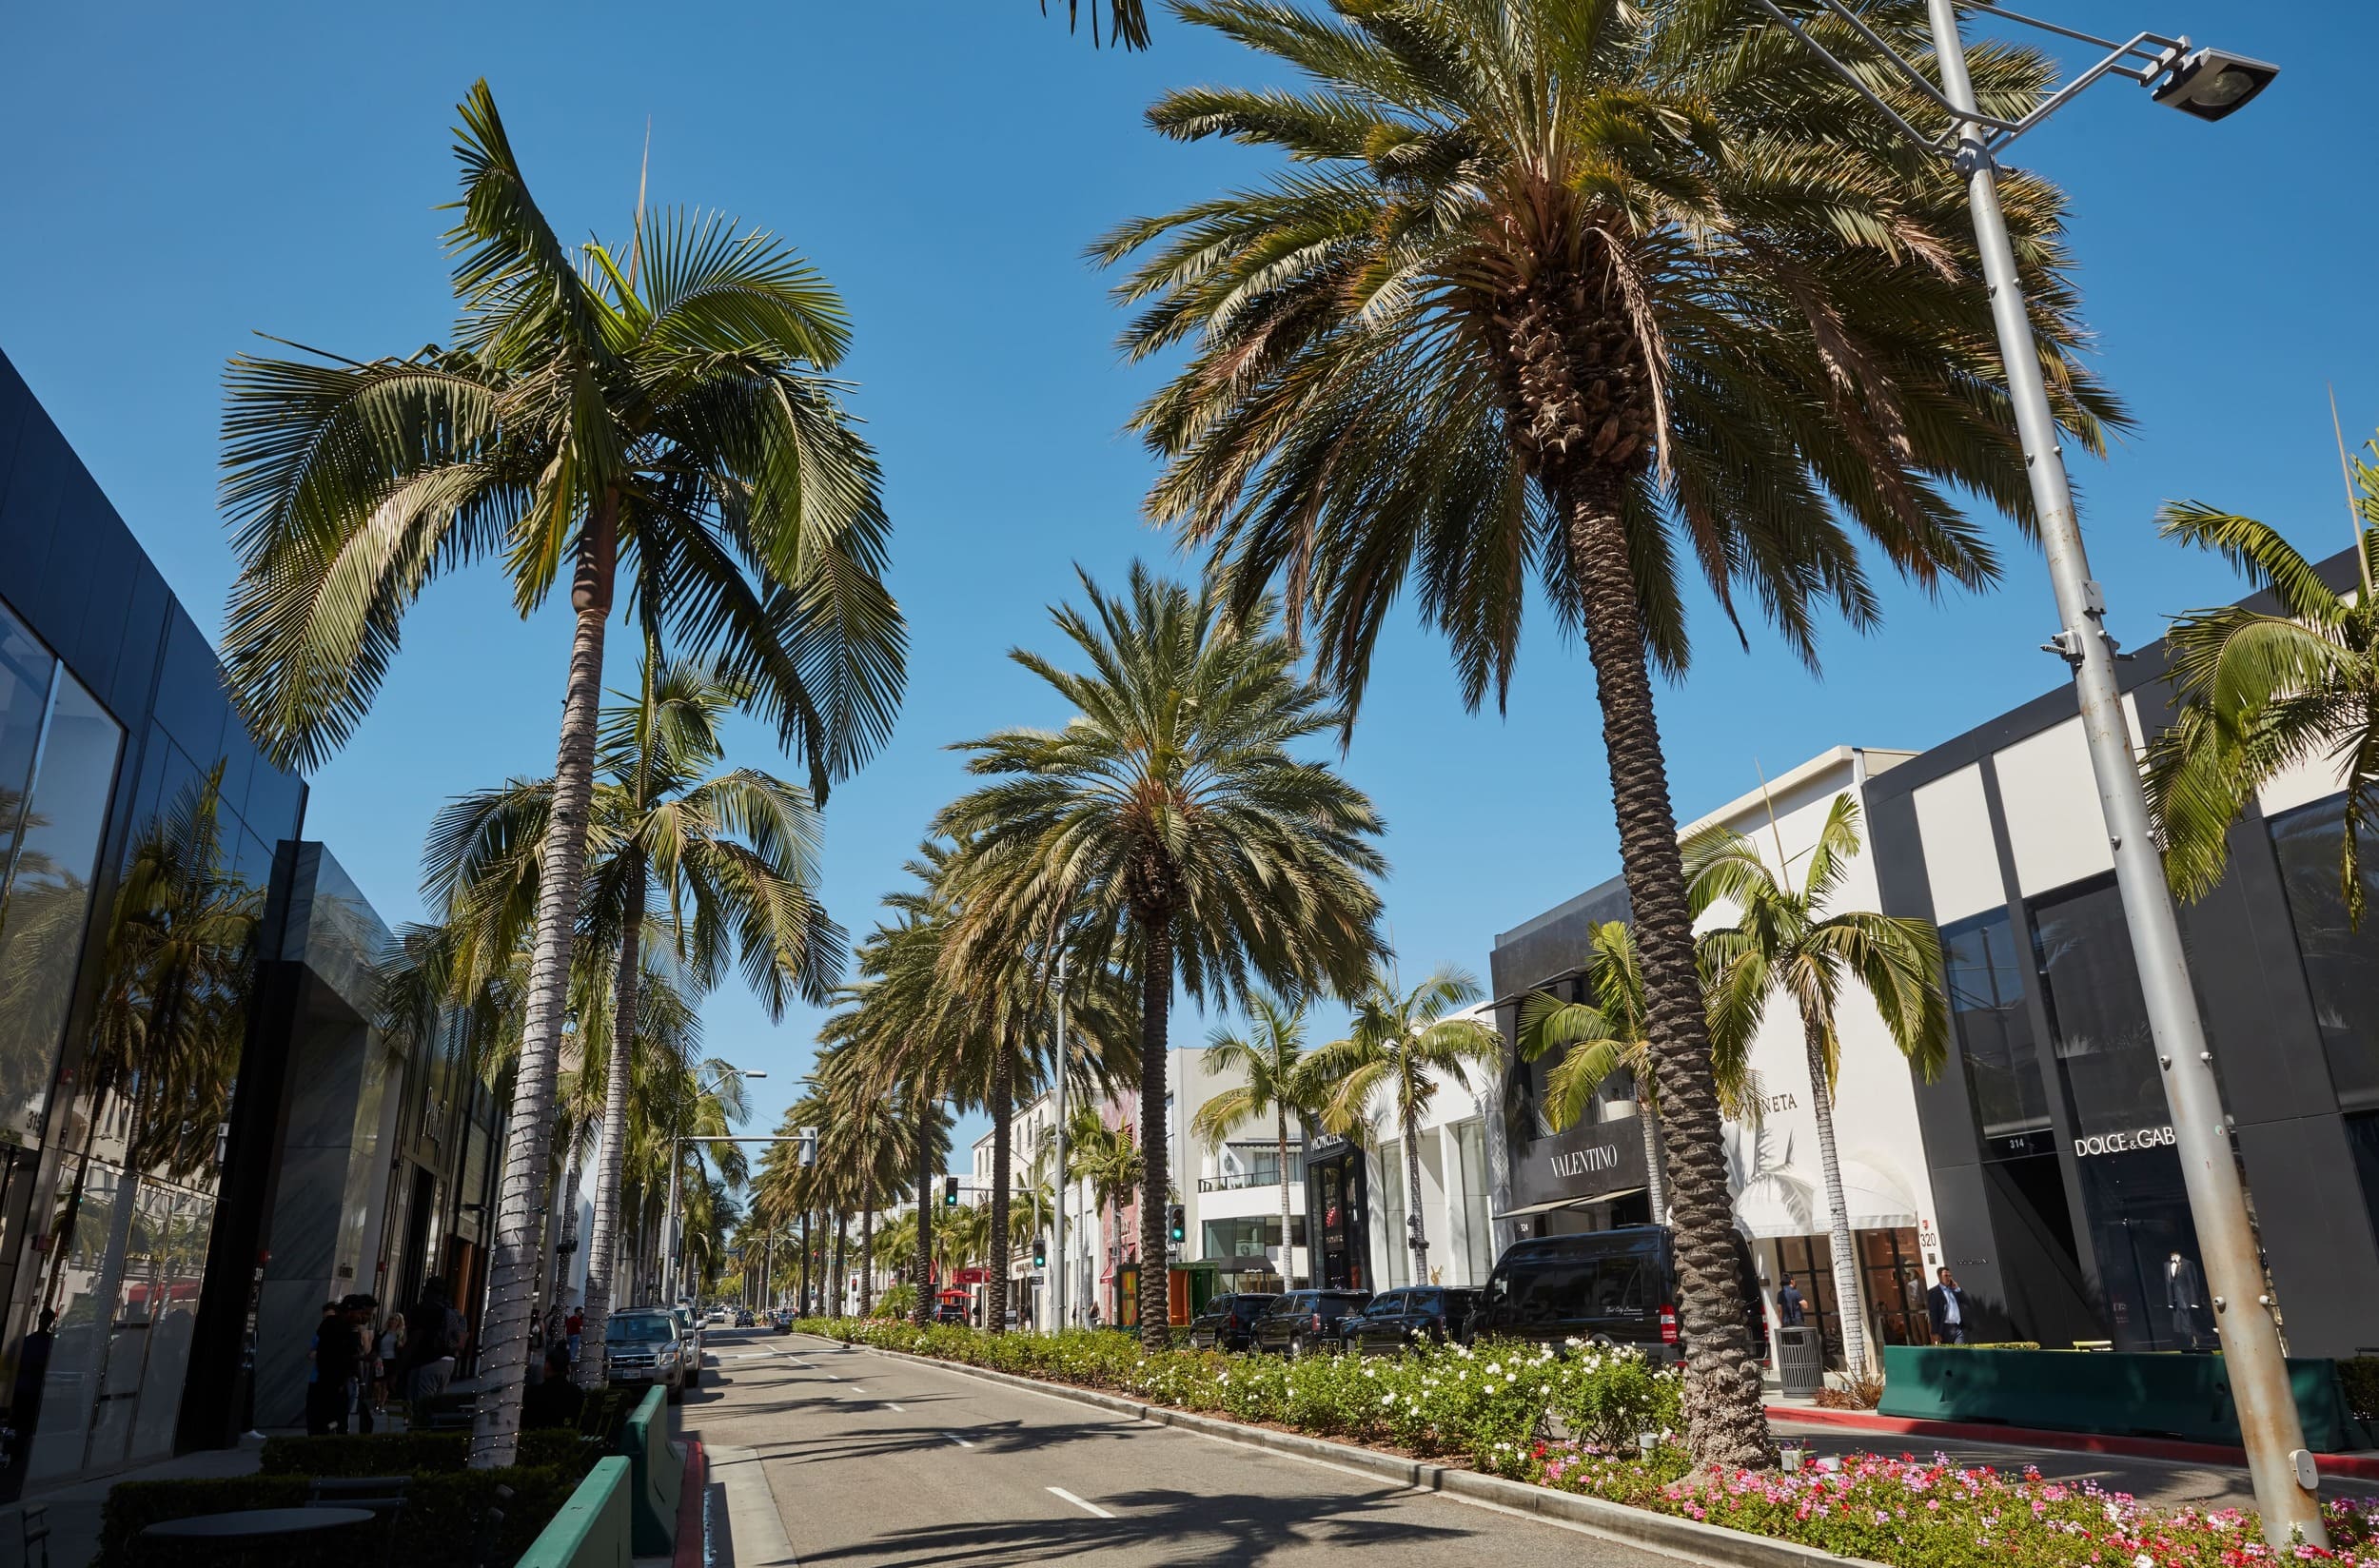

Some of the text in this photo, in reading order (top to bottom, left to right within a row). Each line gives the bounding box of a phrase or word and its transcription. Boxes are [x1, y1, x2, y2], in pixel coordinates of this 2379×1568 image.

[2009, 1137, 2025, 1149] 314
[2074, 1133, 2128, 1157] DOLCE
[2137, 1127, 2176, 1148] GAB
[1550, 1144, 1618, 1178] VALENTINO
[1919, 1232, 1937, 1247] 320
